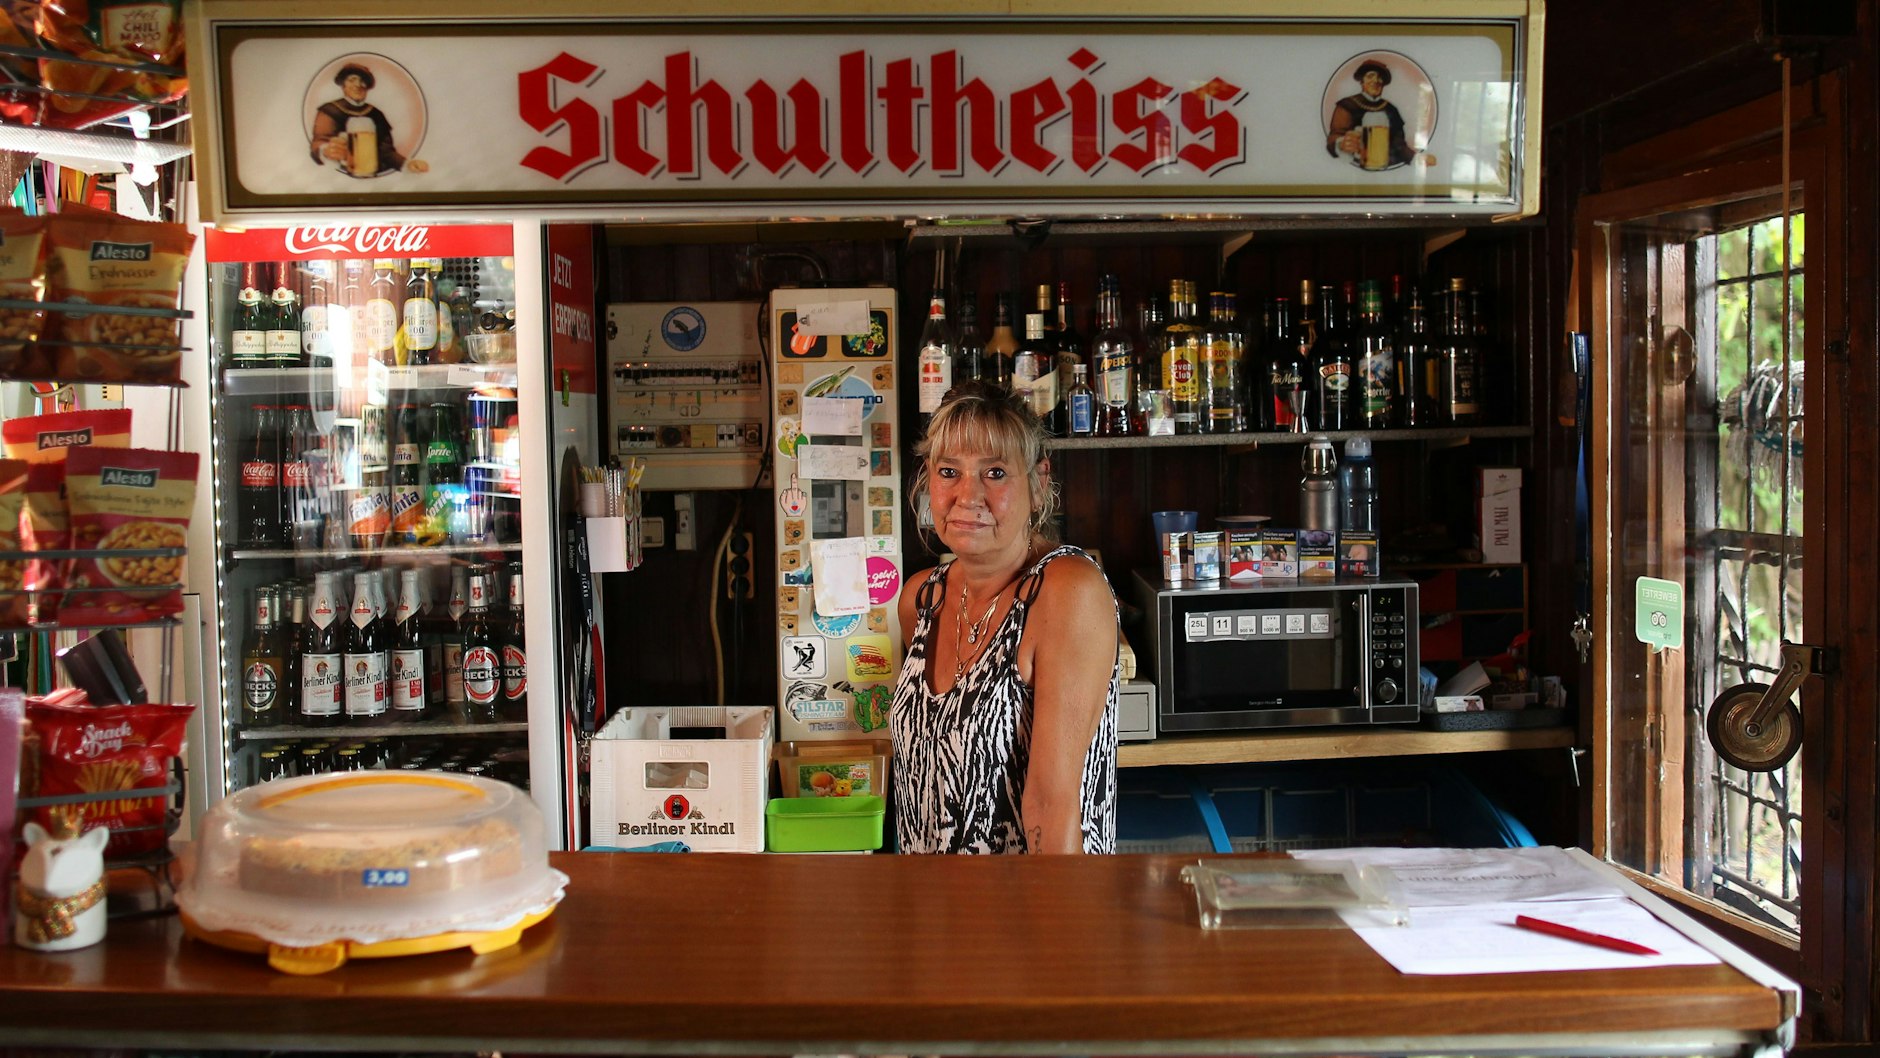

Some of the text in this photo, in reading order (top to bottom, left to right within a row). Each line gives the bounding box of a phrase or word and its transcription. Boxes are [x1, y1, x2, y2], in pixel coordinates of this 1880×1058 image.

[123, 22, 160, 32] CHILI
[120, 32, 160, 41] MAYO
[518, 47, 1249, 184] Schultheiss
[95, 245, 147, 259] Alesto
[554, 253, 572, 290] JETZT
[1100, 355, 1132, 371] APEROL
[1174, 371, 1191, 379] Club
[41, 433, 87, 448] Alesto
[427, 446, 452, 458] Sprite
[104, 471, 152, 485] Alesto
[1190, 620, 1205, 628] 25L
[1216, 619, 1228, 629] 11
[401, 667, 420, 680] Kindl
[464, 667, 500, 680] BECK'S
[796, 702, 845, 713] SILSTAR
[84, 721, 132, 744] Snack
[618, 822, 735, 836] Berliner Kindl
[368, 872, 407, 884] 3,00
